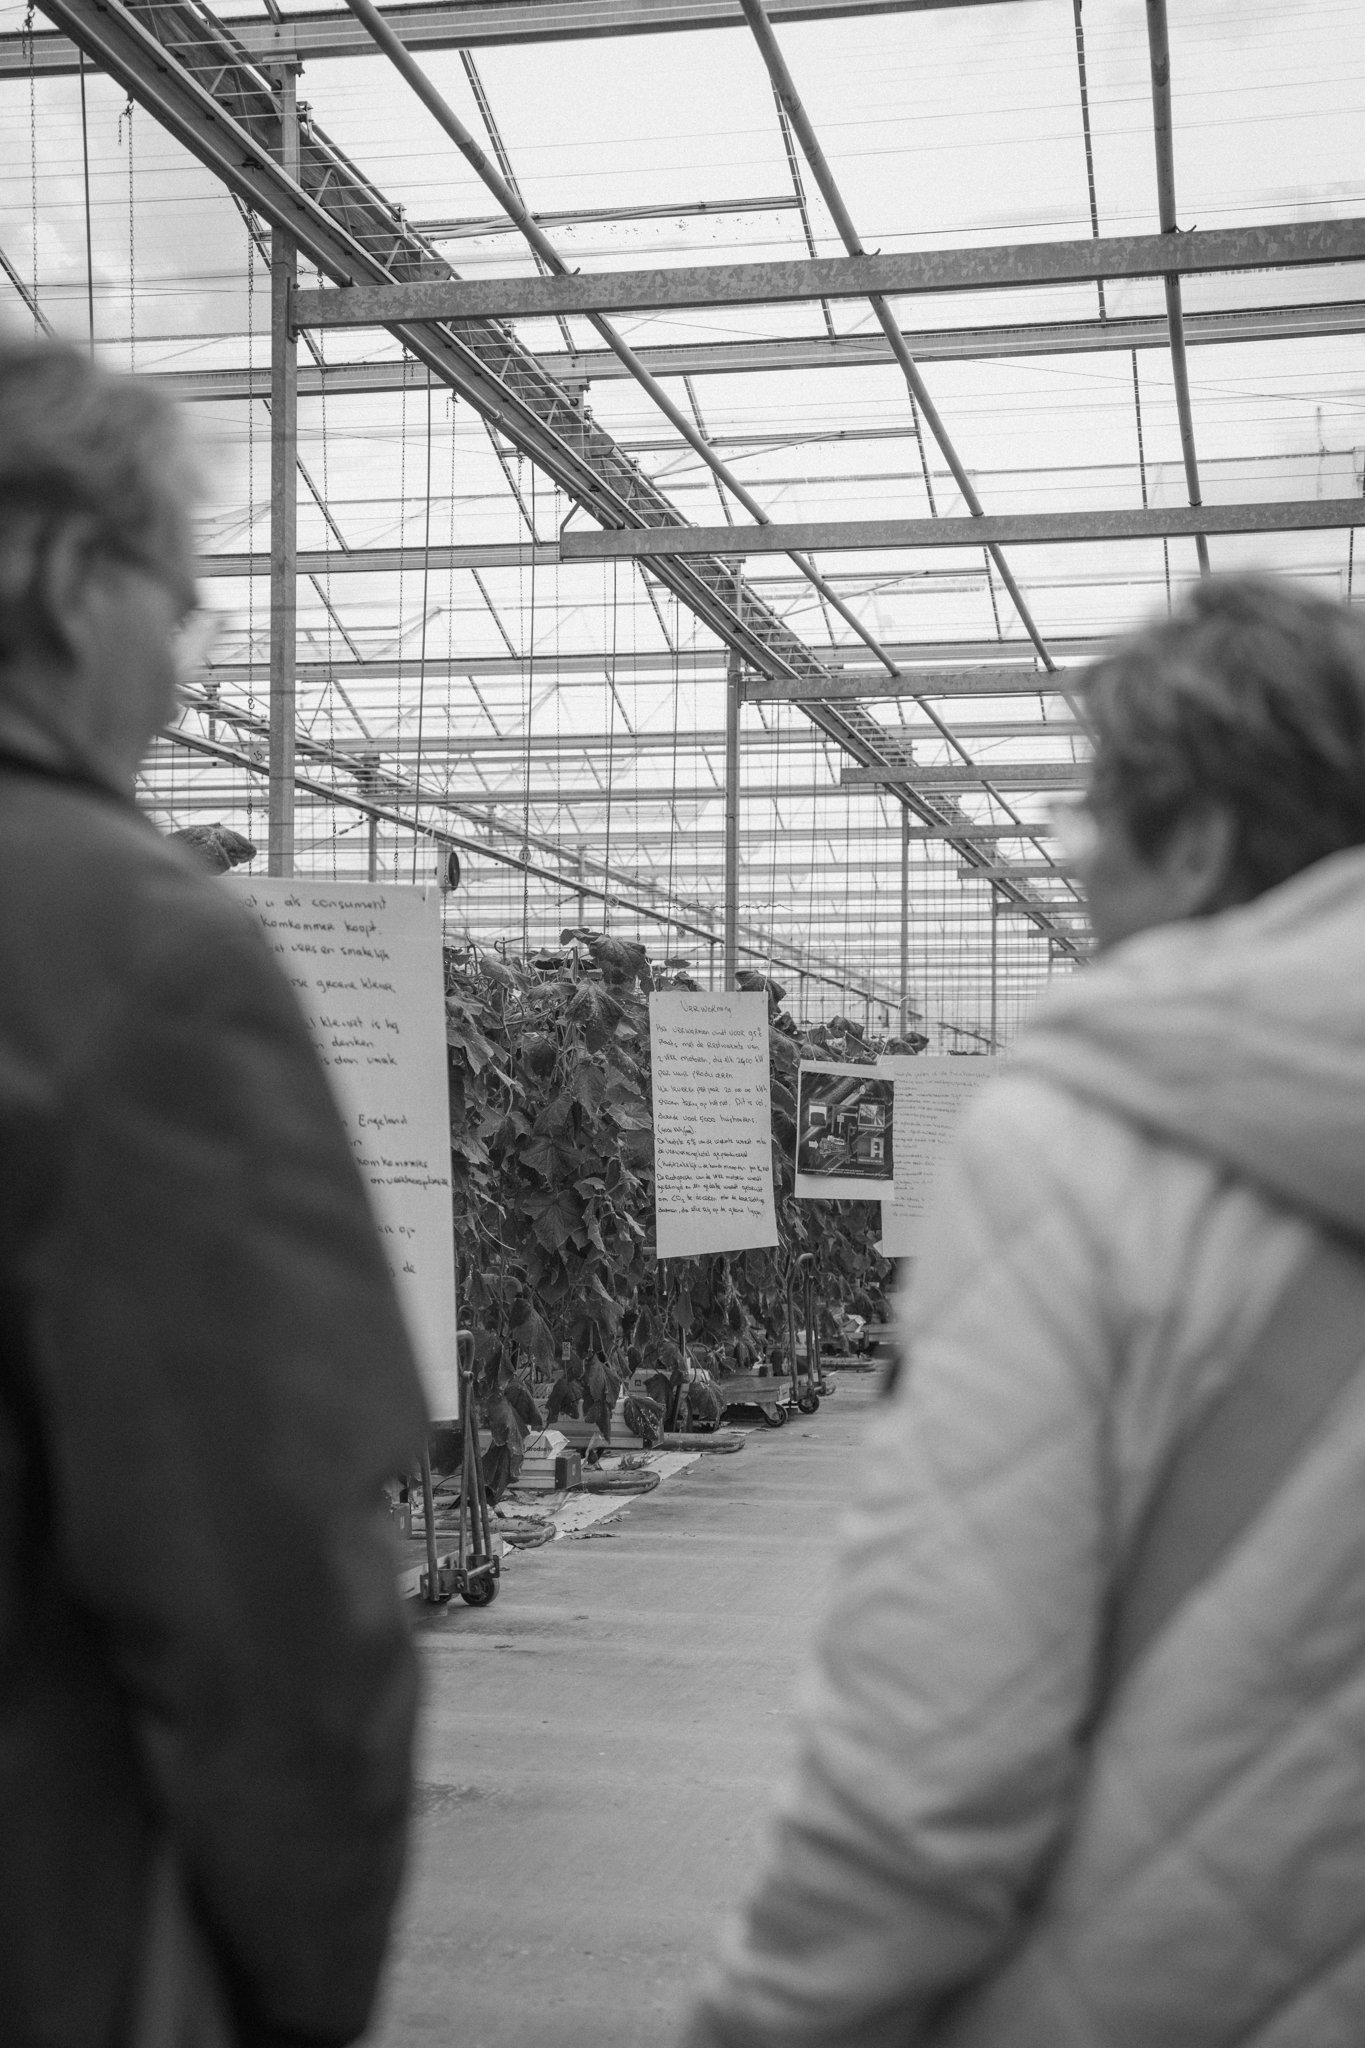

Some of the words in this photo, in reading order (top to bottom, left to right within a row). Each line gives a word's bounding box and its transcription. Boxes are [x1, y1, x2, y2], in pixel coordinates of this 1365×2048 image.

[312, 895, 387, 910] consument
[260, 913, 336, 932] komkommer
[340, 946, 390, 961] smakelijk
[672, 1025, 709, 1036] verwarmen
